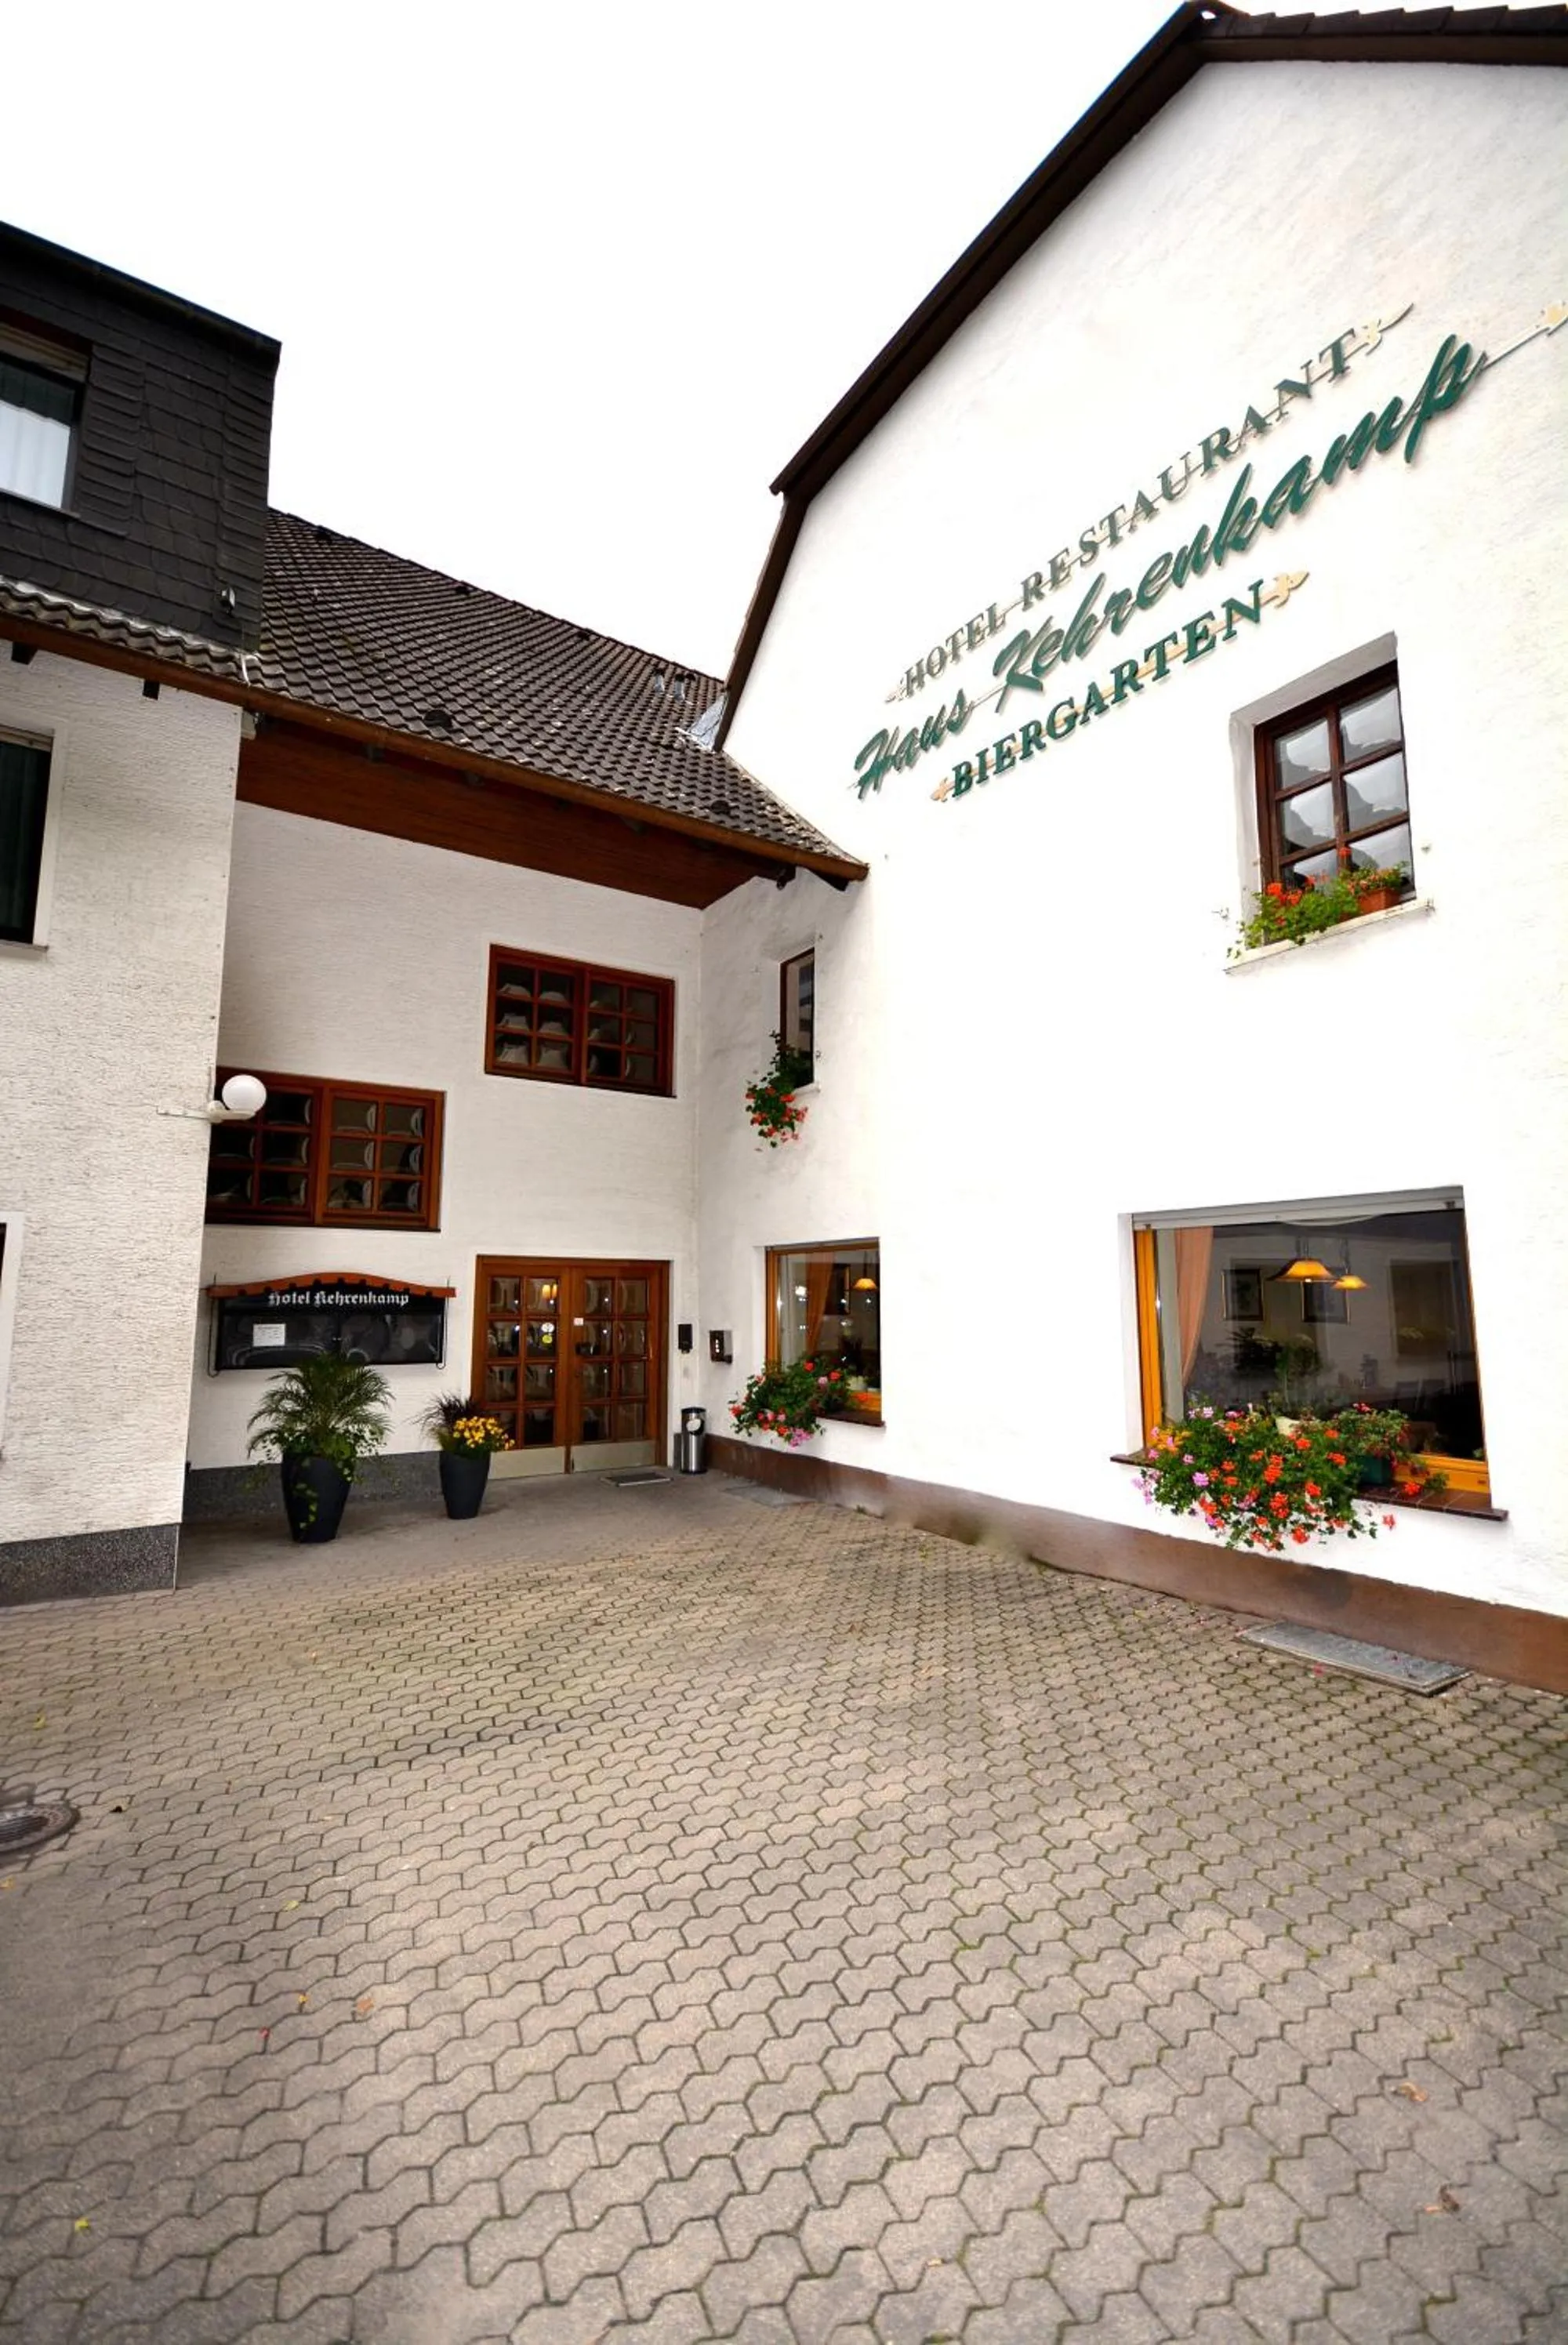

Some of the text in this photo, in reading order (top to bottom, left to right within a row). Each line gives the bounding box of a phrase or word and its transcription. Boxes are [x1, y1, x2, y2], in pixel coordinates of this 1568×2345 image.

[852, 334, 1486, 800] Haus Kehrenkamp
[903, 328, 1356, 699] HOTEL RESTAURANT
[951, 579, 1266, 798] BIERGARTEN
[269, 1290, 409, 1307] Hotel Kehrenkamp
